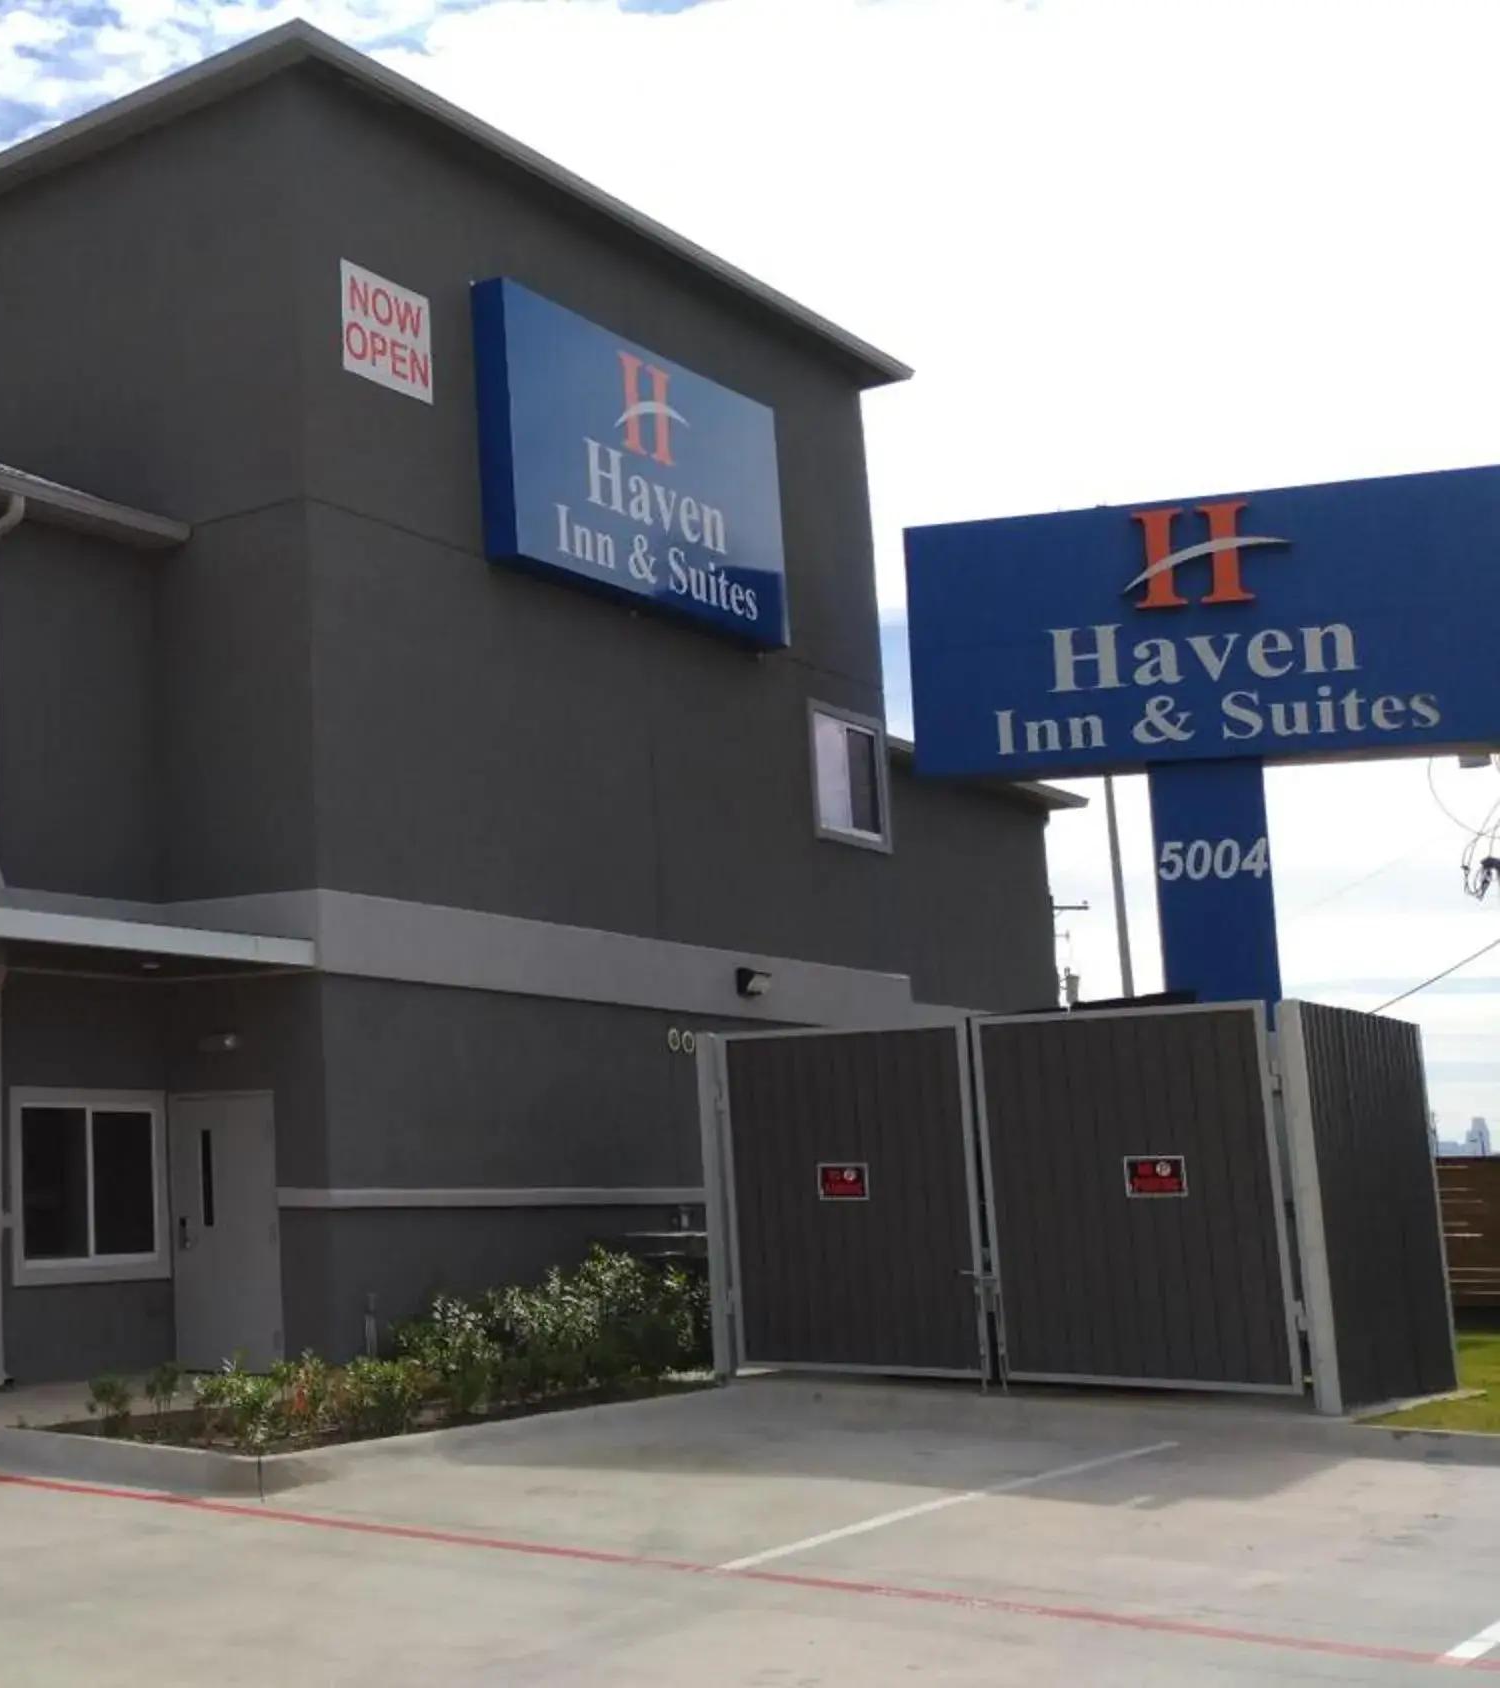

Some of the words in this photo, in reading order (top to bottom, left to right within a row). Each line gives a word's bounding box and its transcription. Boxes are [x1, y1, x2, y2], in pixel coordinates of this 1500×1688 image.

[349, 274, 422, 338] NOW
[346, 321, 429, 388] OPEN
[619, 352, 675, 467] H
[585, 438, 727, 553] Haven
[556, 504, 616, 569] Inn
[628, 533, 656, 584] &
[669, 547, 758, 621] Suites
[1130, 501, 1256, 610] H
[1048, 622, 1358, 693] Haven
[994, 709, 1106, 755] Inn
[1132, 695, 1195, 745] &
[1221, 685, 1441, 740] Suites
[1159, 838, 1270, 881] 5004
